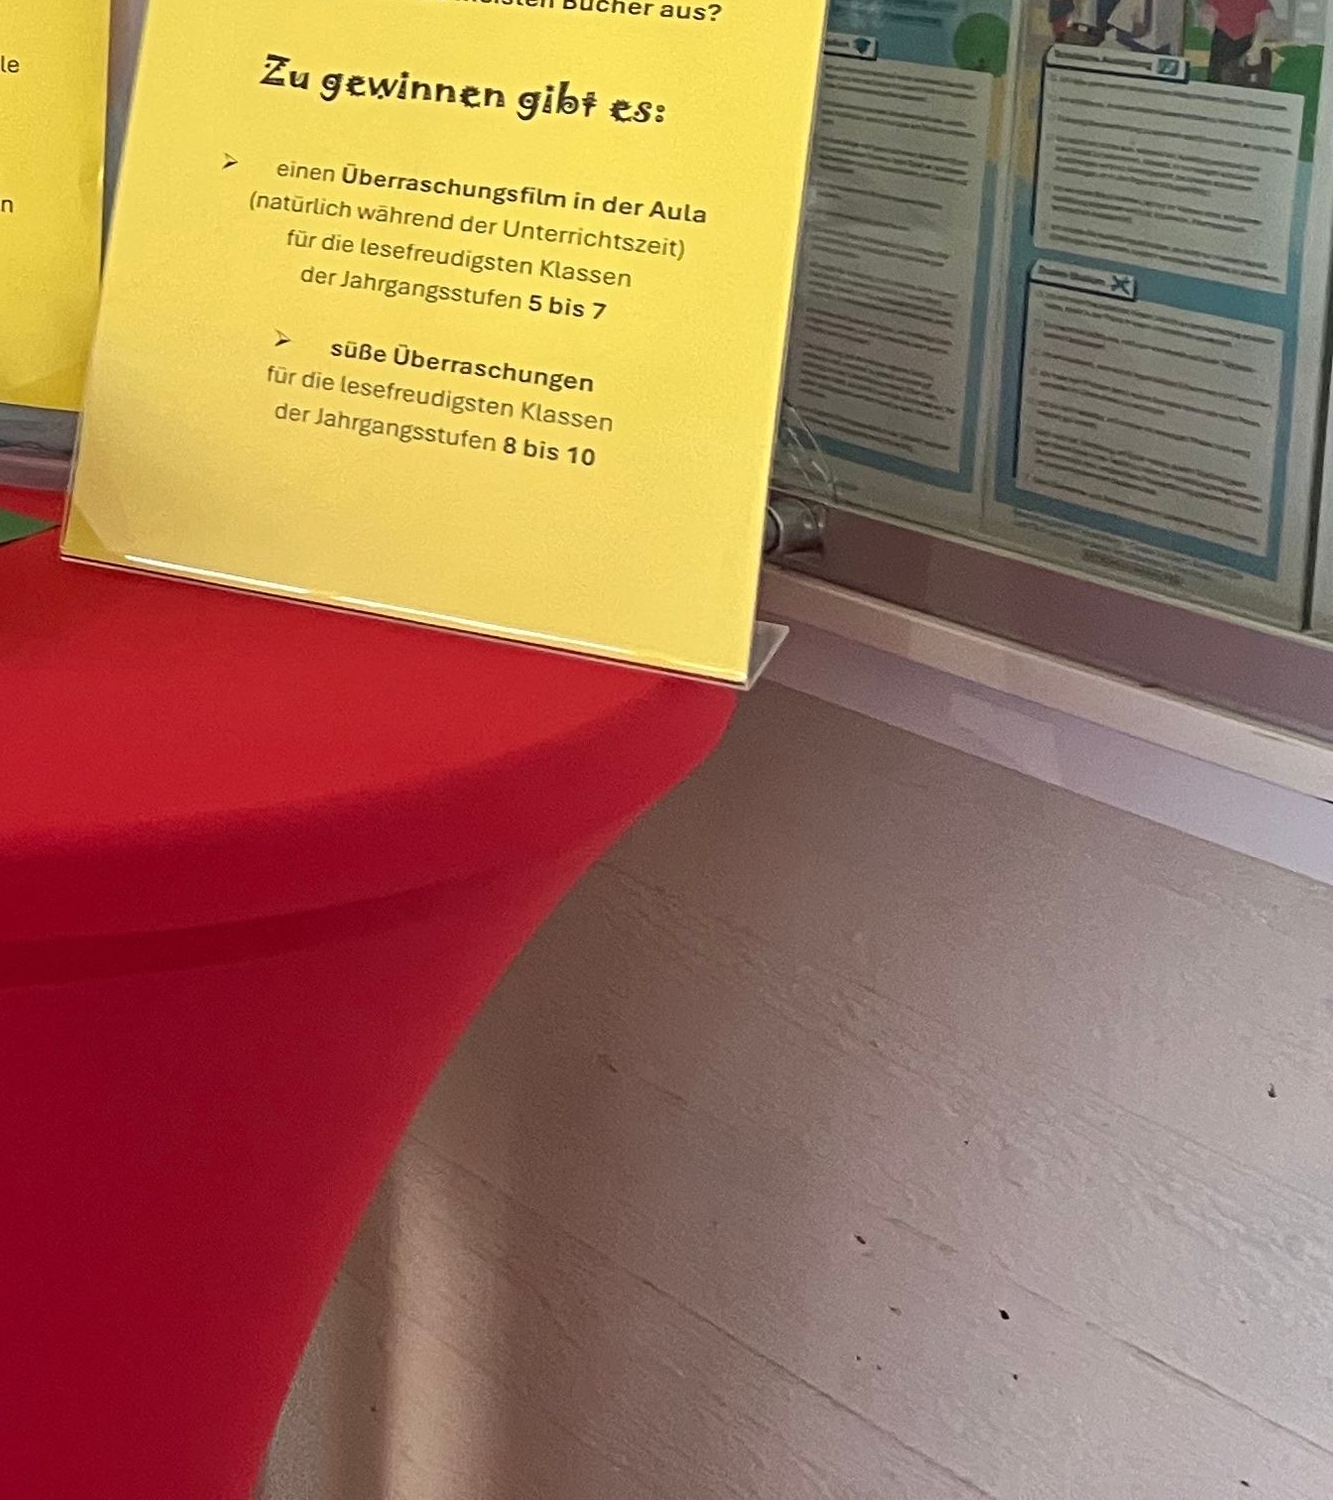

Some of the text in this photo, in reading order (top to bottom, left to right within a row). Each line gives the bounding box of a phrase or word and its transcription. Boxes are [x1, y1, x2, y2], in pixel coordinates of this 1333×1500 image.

[659, 3, 723, 22] aus?
[259, 53, 666, 123] Zu gewinnen gibt es:
[276, 163, 707, 224] einen Überraschungsfilm in der Aula
[249, 190, 685, 262] (natürlich während der Unterrichtszeit)
[287, 228, 632, 288] für die lesefreudigsten Klassen
[299, 266, 607, 320] der Jahrgangsstufen 5 bis 7
[330, 340, 594, 393] süße Überraschungen
[267, 364, 613, 432] für die lesefreudigsten Klassen
[274, 402, 596, 467] der Jahrgangsstufen 8 bis 10
